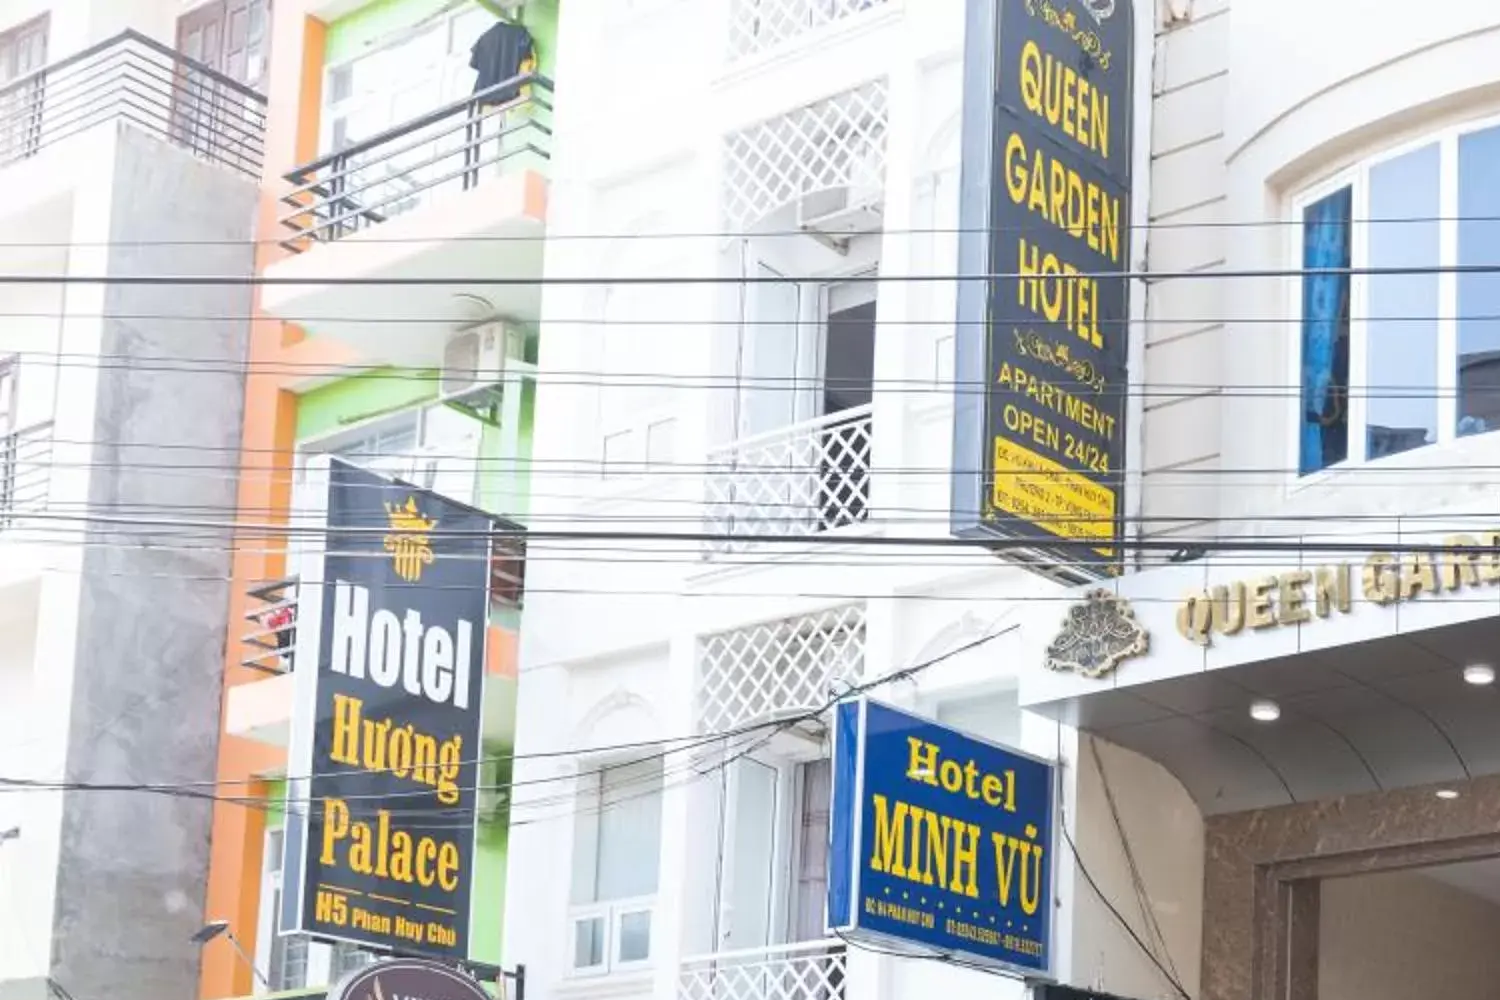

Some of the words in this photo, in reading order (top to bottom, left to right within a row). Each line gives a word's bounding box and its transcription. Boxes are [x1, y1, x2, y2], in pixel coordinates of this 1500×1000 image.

[1020, 40, 1108, 158] QUEEN
[1005, 133, 1118, 262] GARDEN
[1019, 238, 1103, 349] HOTEL
[997, 363, 1115, 441] APARTMENT
[1003, 404, 1059, 450] OPEN
[1063, 433, 1109, 476] 24/24
[330, 579, 473, 710] Hotel
[1176, 560, 1352, 648] QUEEN
[330, 693, 463, 804] Hương
[906, 735, 1017, 812] Hotel
[319, 797, 460, 893] Palace
[870, 793, 981, 898] MINH
[991, 823, 1042, 915] VŨ
